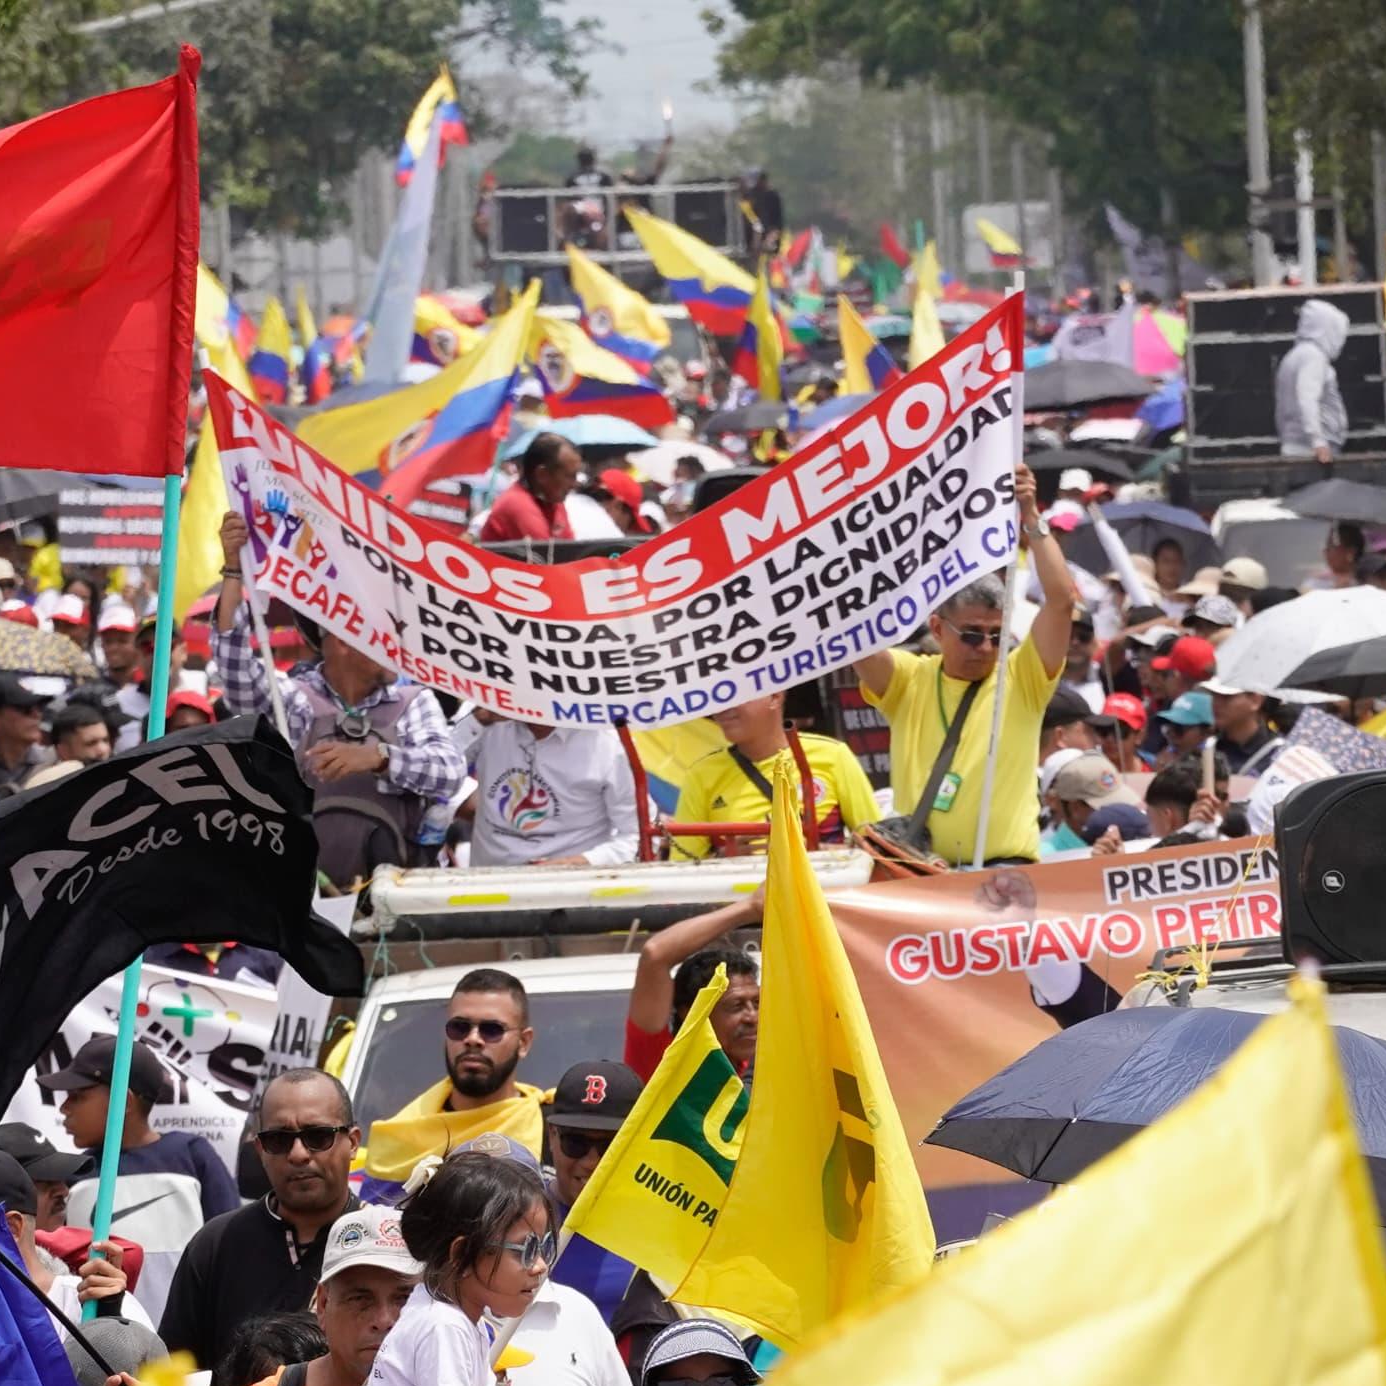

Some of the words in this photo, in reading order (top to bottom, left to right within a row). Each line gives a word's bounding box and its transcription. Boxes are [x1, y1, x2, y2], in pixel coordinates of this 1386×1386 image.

[340, 526, 414, 594] POR
[426, 583, 484, 626] LA
[493, 611, 637, 645] VIDA,
[651, 574, 755, 634] POR
[763, 536, 825, 585] LA
[830, 386, 1012, 546] IGUALDAD
[579, 537, 704, 615] ES
[720, 318, 1012, 565] MEJOR!
[417, 604, 513, 660] POR
[524, 609, 761, 670] NUESTRA
[770, 467, 969, 617] DIGNIDAD
[421, 633, 515, 686] POR
[530, 621, 797, 697] NUESTROS
[806, 472, 1014, 631] TRABAJOS
[552, 679, 738, 726] MERCADO
[746, 595, 919, 693] TURÍSTICO
[921, 548, 980, 606] DEL
[57, 826, 182, 905] Desde
[193, 809, 285, 856] 1998
[887, 914, 1143, 984] GUSTAVO
[582, 1074, 607, 1105] B
[633, 1162, 696, 1215] UNIÓN
